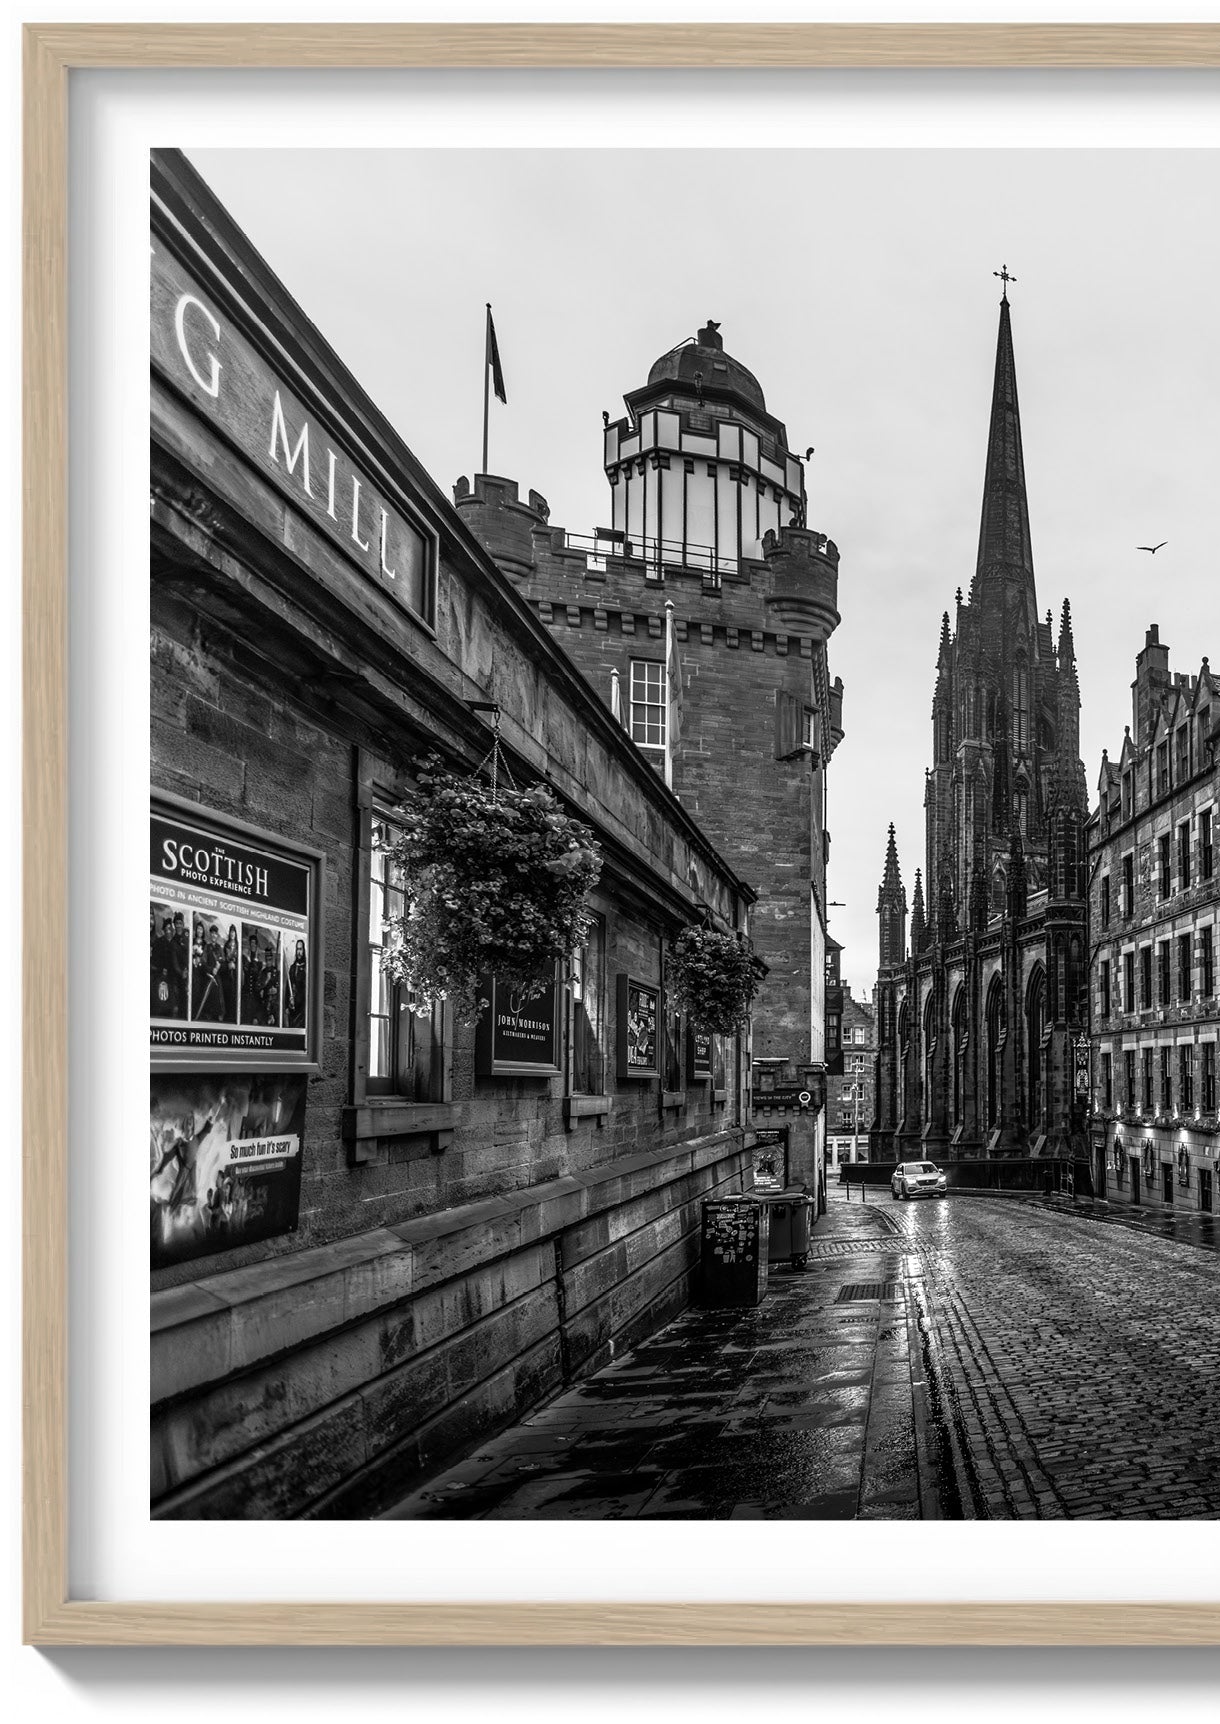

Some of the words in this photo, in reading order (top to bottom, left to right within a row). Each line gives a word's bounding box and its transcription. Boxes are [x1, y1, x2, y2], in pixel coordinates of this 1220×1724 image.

[267, 389, 396, 580] MILL
[215, 846, 226, 855] THE
[162, 839, 269, 897] SCOTTISH
[181, 868, 208, 883] PHOTO
[209, 876, 252, 895] EXPERIENCE
[177, 889, 186, 900] IN
[188, 893, 218, 908] ANCIENT
[219, 901, 250, 916] SCOTTISH
[250, 909, 280, 923] HIGHLAND
[281, 917, 305, 930] COSTUME
[497, 1014, 516, 1027] JOHN
[518, 1018, 550, 1031] MORRISON
[190, 1031, 229, 1044] PRINTED
[231, 1034, 274, 1047] INSTANTLY
[230, 1144, 239, 1159] So
[239, 1142, 256, 1158] much
[256, 1141, 267, 1156] fun
[267, 1140, 276, 1155] it's
[276, 1141, 291, 1154] scary
